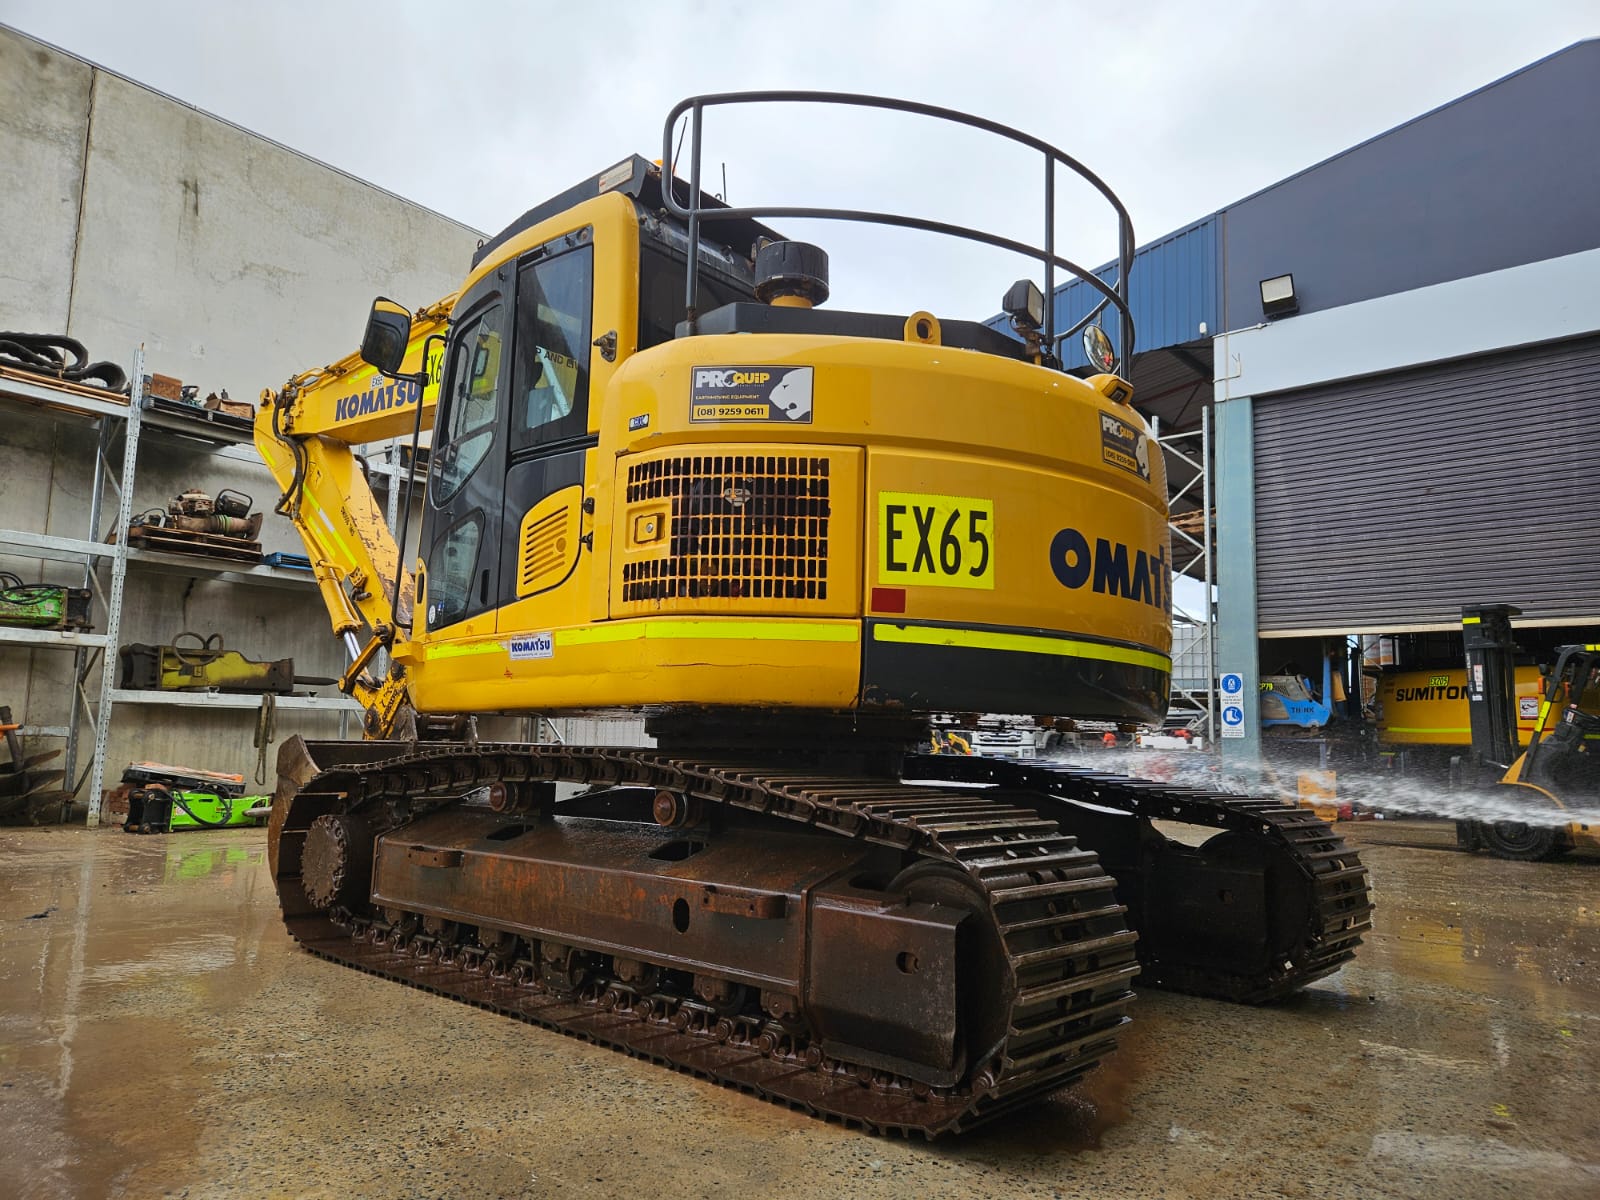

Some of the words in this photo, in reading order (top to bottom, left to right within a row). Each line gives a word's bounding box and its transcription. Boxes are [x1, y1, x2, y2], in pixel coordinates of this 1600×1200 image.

[335, 377, 419, 421] KOMATSU
[697, 408, 716, 416] (08)
[718, 408, 742, 416] 9259
[744, 408, 764, 416] 0611
[886, 504, 989, 577] EX65
[511, 638, 550, 652] KOMATSU
